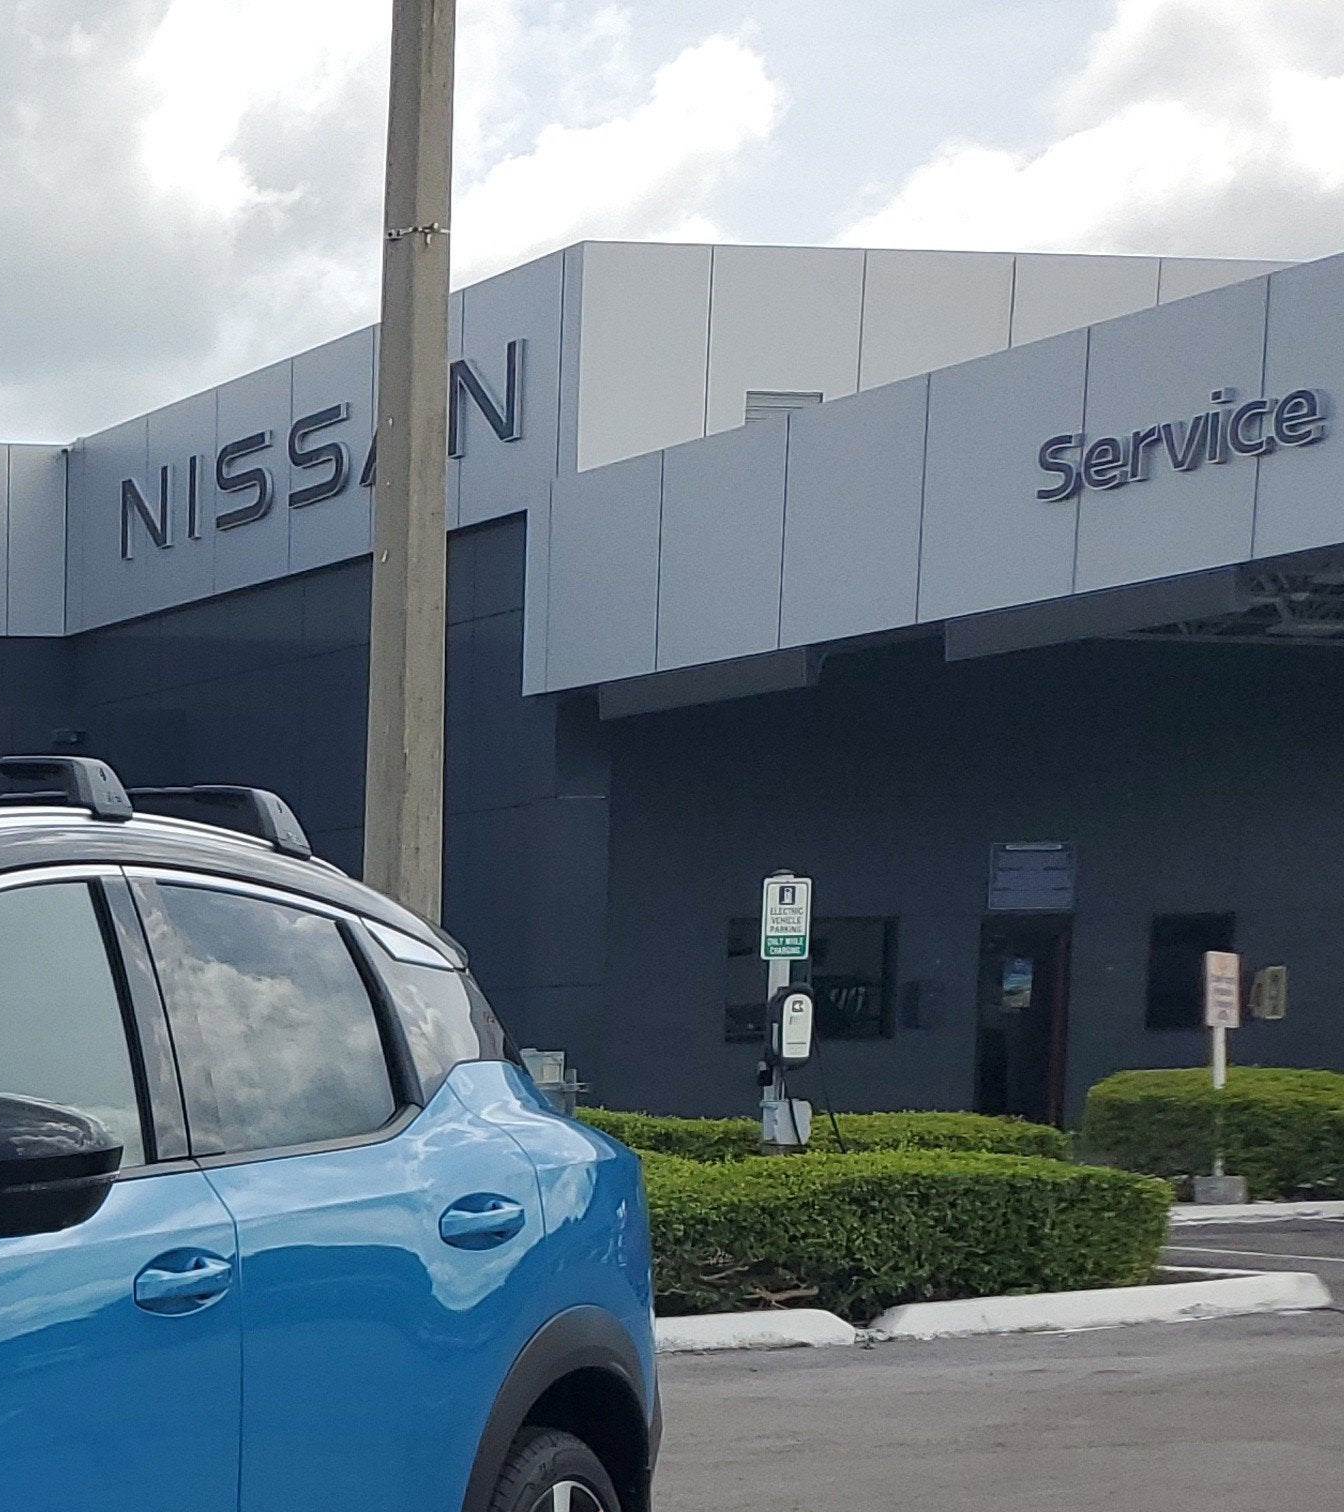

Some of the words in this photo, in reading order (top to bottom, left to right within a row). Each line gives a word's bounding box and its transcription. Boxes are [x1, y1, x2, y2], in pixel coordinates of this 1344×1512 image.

[120, 338, 527, 561] NISSN
[1036, 387, 1329, 503] Service
[770, 907, 804, 916] ELECTRIC
[771, 917, 802, 925] VEHICLE
[769, 926, 802, 934] PARKING
